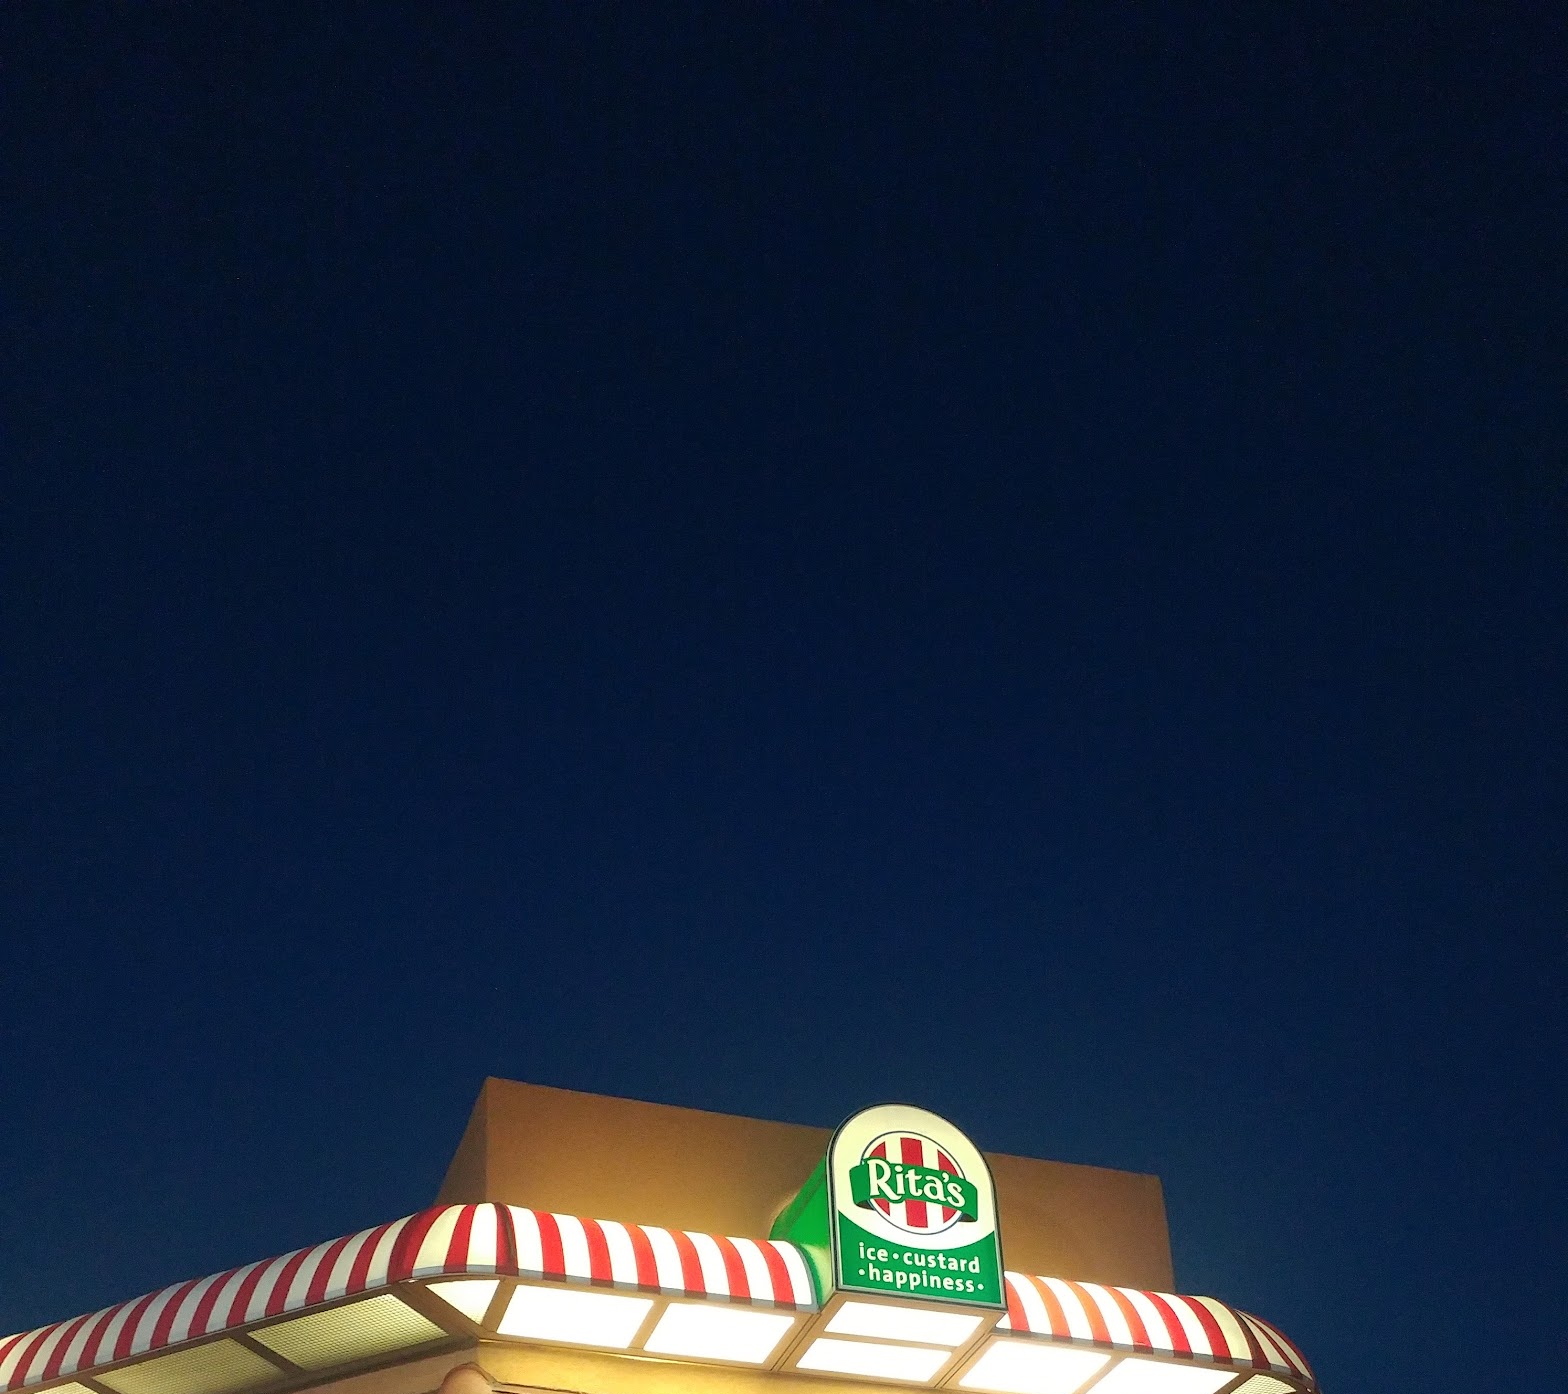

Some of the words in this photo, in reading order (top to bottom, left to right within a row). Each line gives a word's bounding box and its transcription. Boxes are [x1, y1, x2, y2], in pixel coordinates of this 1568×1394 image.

[868, 1159, 966, 1207] Rita's
[859, 1242, 889, 1261] ice
[903, 1252, 980, 1273] custard
[869, 1263, 975, 1292] happiness
